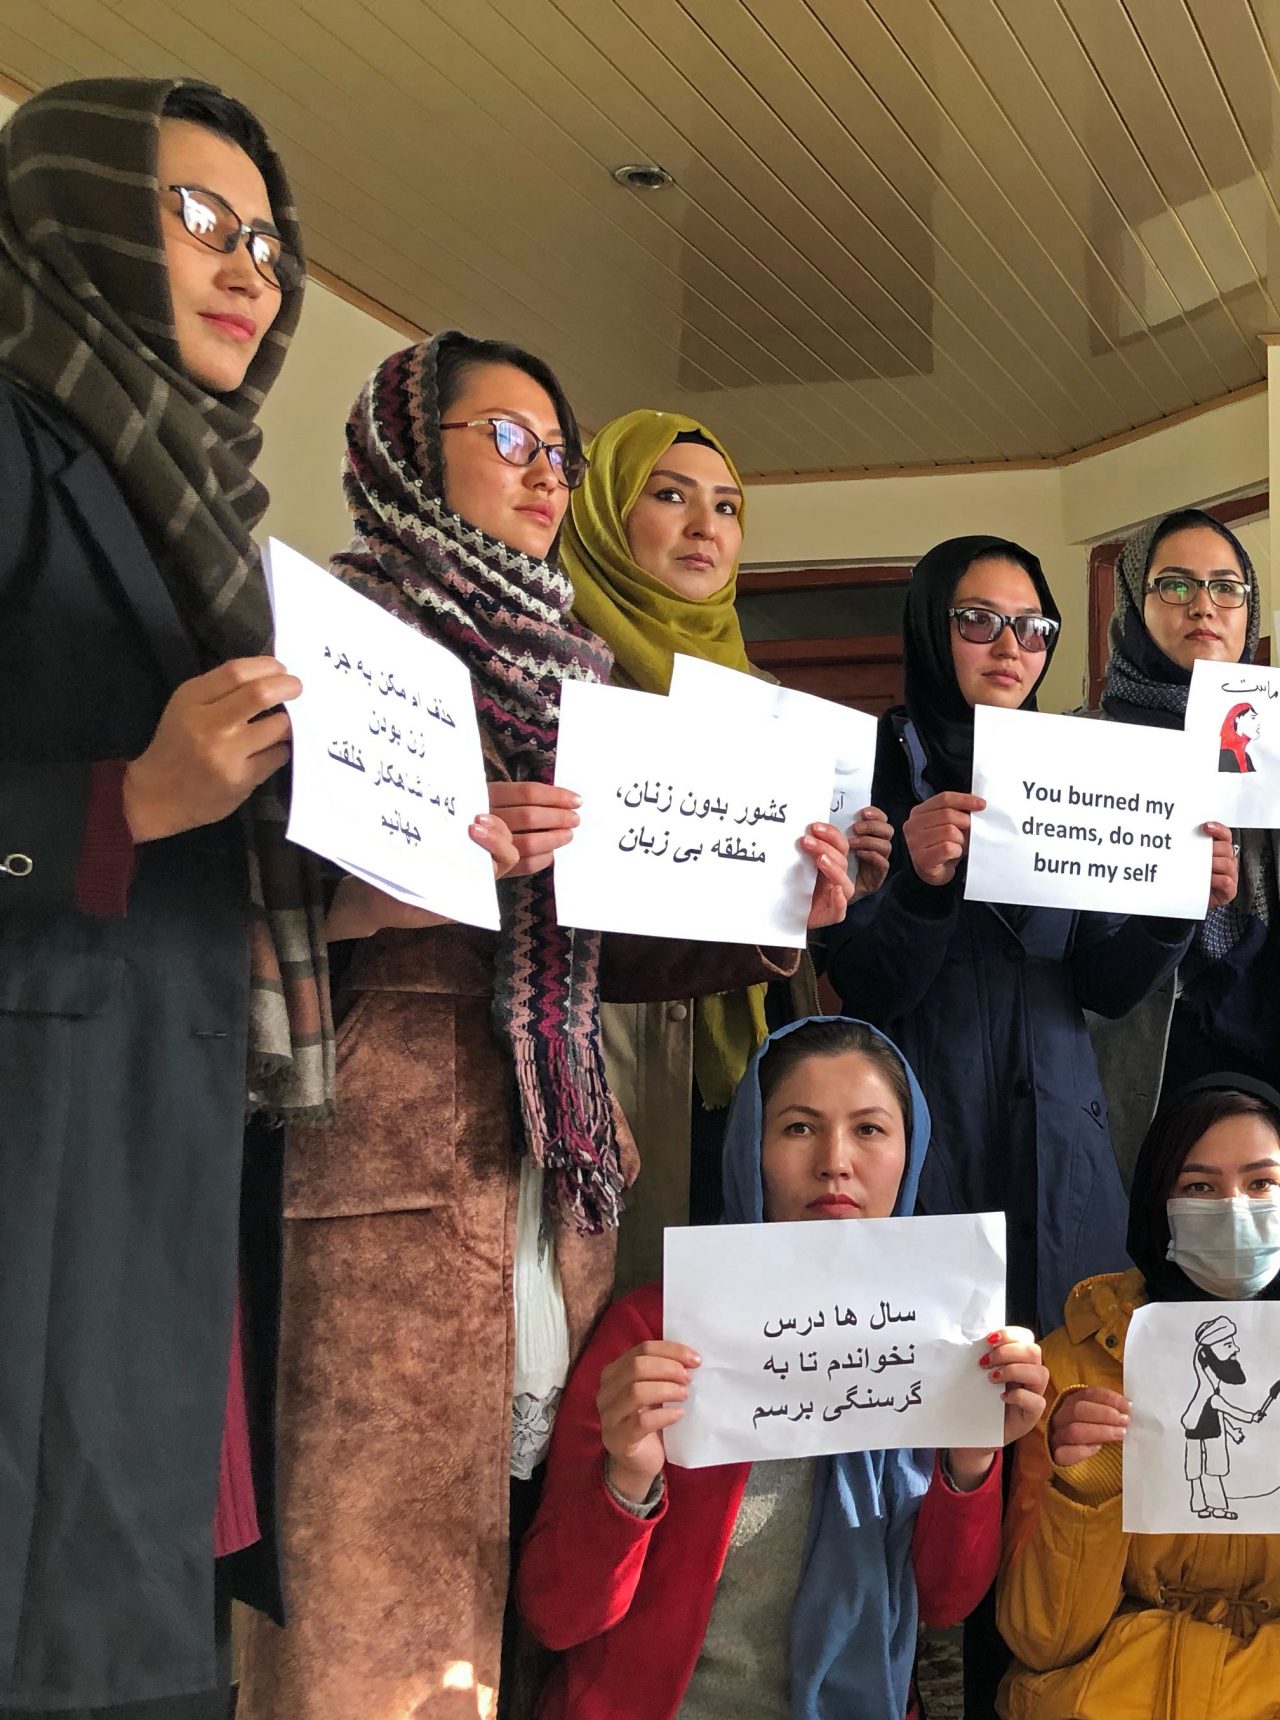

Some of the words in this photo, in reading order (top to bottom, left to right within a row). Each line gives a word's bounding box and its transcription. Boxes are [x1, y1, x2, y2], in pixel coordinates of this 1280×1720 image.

[328, 741, 365, 772] خلقت
[617, 781, 673, 812] زنان،
[680, 792, 728, 821] بدون
[1023, 781, 1061, 803] You
[1069, 785, 1139, 811] burned
[1146, 800, 1174, 820] my
[734, 800, 787, 826] کشور
[619, 826, 670, 856] زبان
[1022, 816, 1102, 845] dreams,
[1110, 826, 1134, 845] do
[1141, 834, 1171, 850] not
[673, 843, 703, 863] بی
[711, 837, 765, 863] منطقه
[1034, 852, 1081, 875] burn
[1088, 863, 1118, 883] my
[1123, 864, 1157, 882] self
[764, 1311, 824, 1338] درس
[835, 1305, 857, 1326] ها
[870, 1301, 915, 1330] سال
[763, 1356, 788, 1380] به
[799, 1352, 817, 1371] تا
[827, 1344, 915, 1381] نخواندم
[753, 1401, 813, 1429] برسم
[823, 1380, 921, 1422] گرسنگی
